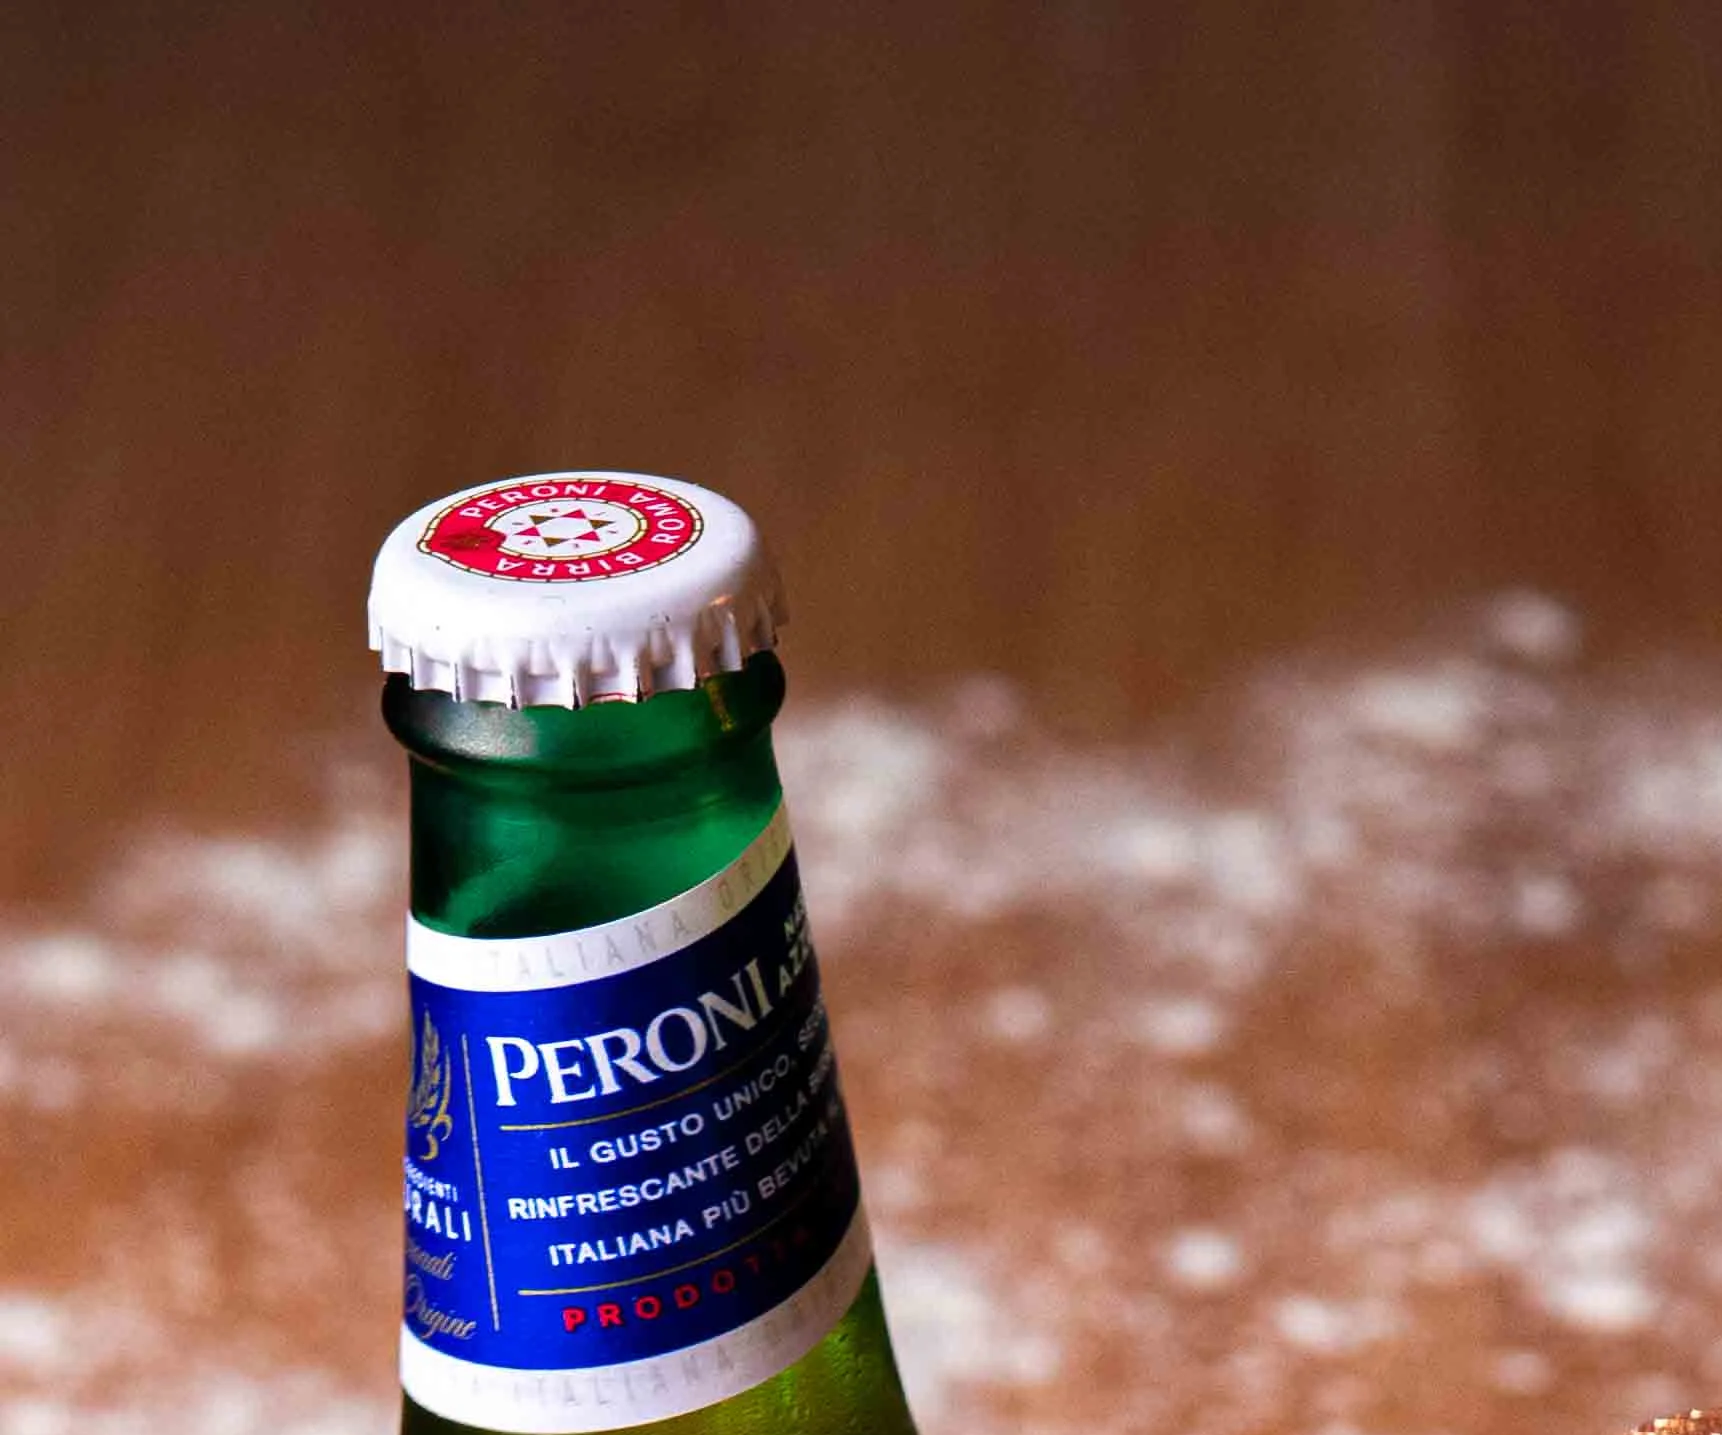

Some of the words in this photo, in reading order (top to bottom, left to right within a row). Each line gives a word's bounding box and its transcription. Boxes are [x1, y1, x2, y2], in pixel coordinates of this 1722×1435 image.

[459, 481, 608, 521] PERONI
[629, 491, 686, 546] ROMA
[497, 550, 645, 578] BIRRA
[485, 957, 775, 1108] PERONI
[508, 1148, 741, 1222] RINFRESCANTE
[746, 1090, 809, 1155] DELLA
[549, 1142, 580, 1171] IL
[591, 1111, 703, 1164] GUSTO
[548, 1218, 696, 1268] ITALIANA
[703, 1183, 752, 1233] PIÙ
